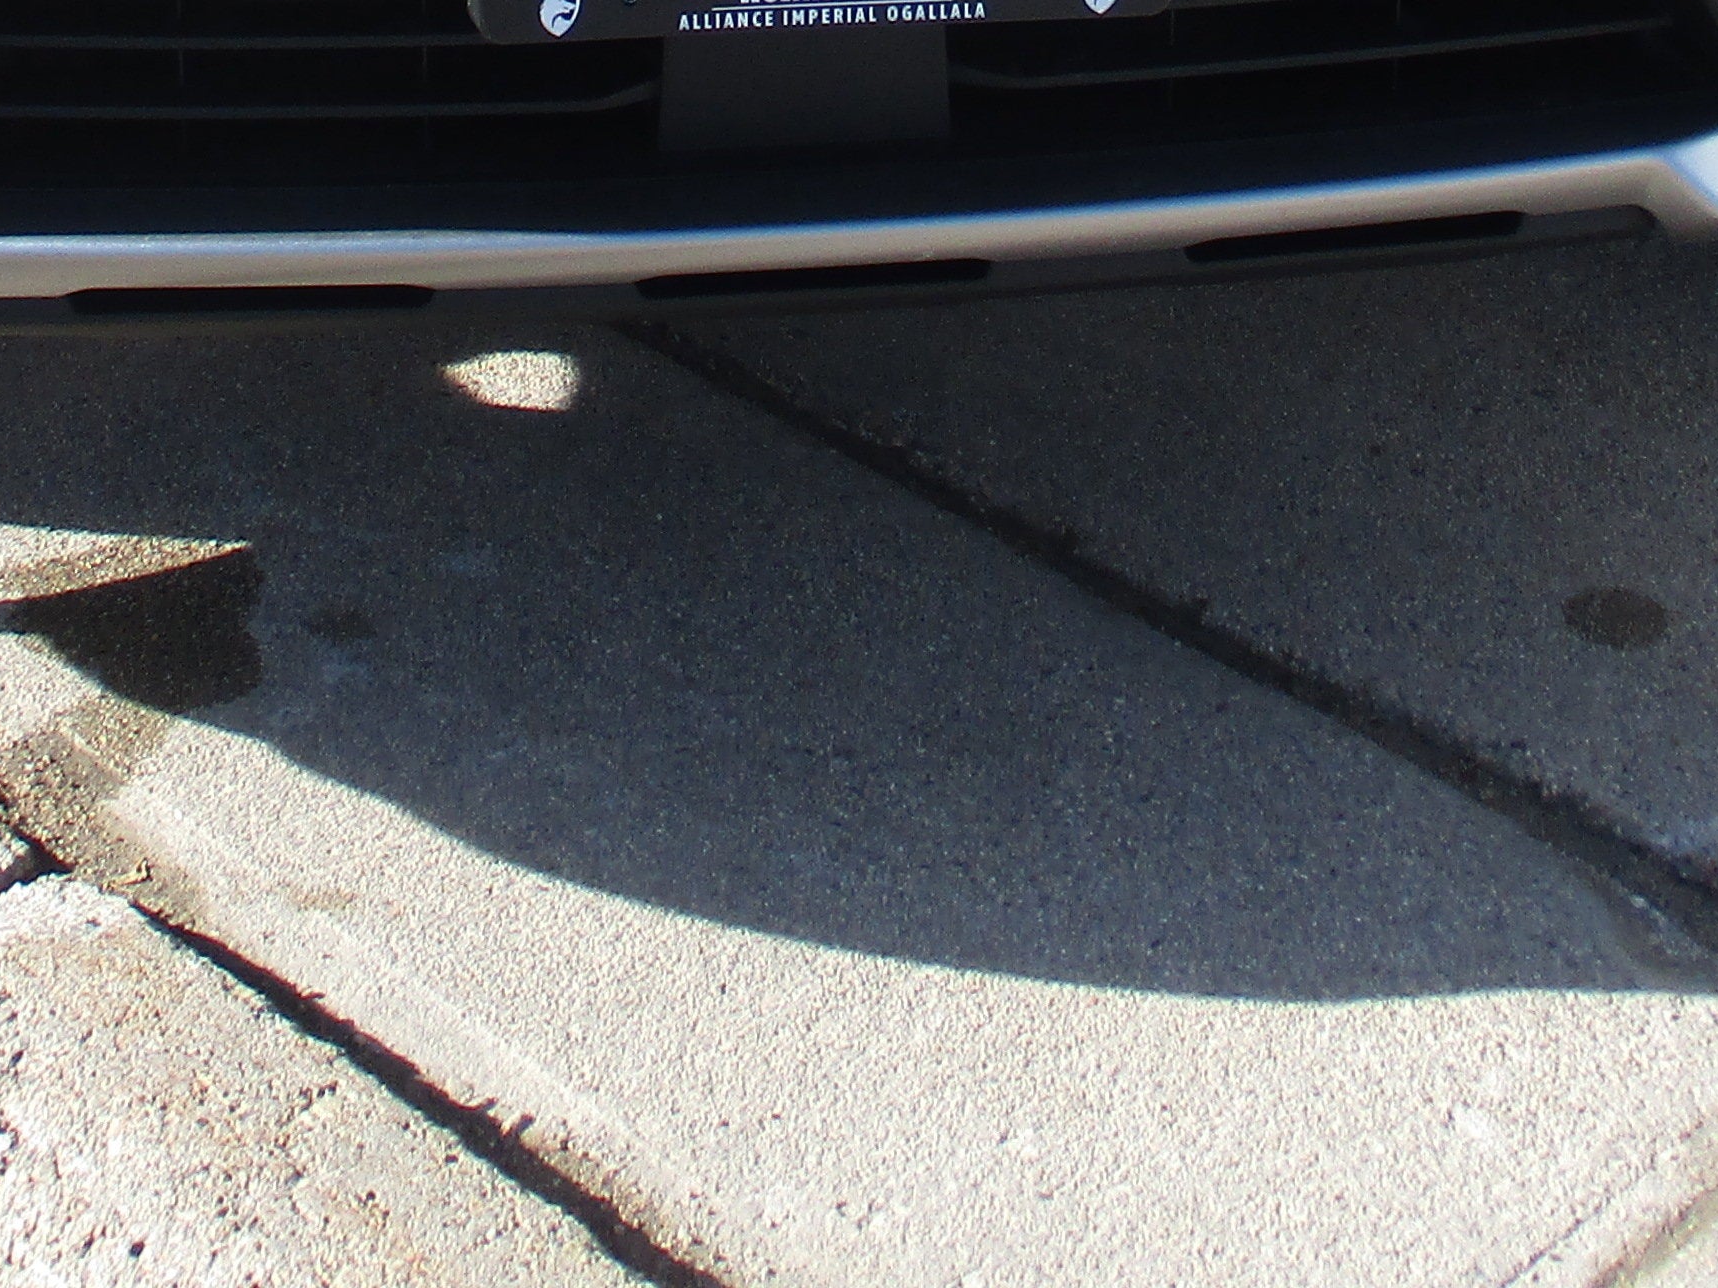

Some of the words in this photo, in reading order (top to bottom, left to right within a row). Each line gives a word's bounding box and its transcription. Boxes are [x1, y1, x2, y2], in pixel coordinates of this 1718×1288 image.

[678, 10, 774, 31] ALLIANCE
[783, 6, 878, 27] IMPERIAL
[886, 2, 986, 23] OGALLALA
